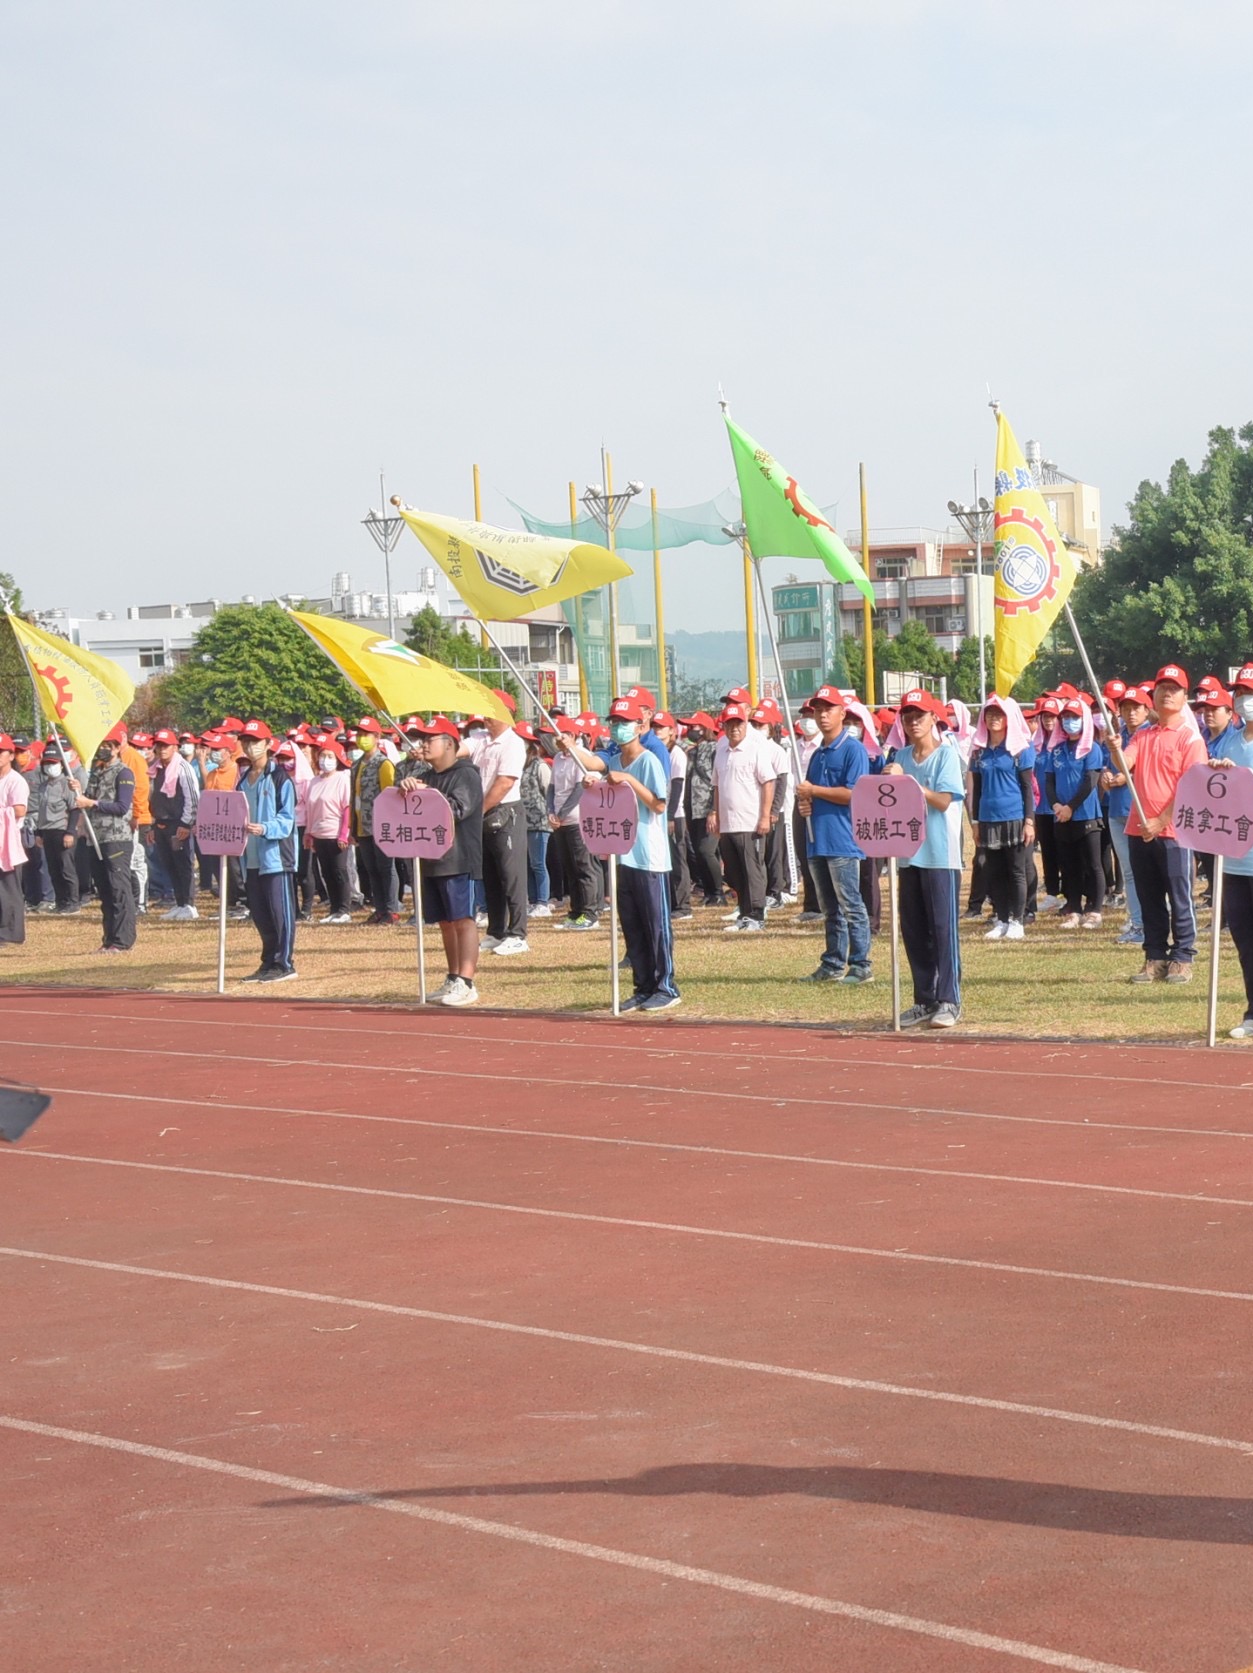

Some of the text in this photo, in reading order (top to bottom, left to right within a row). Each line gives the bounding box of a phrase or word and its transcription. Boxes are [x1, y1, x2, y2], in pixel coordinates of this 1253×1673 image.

[878, 783, 897, 807] 8
[1206, 772, 1228, 799] 6
[215, 796, 229, 816] 14
[402, 794, 423, 816] 12
[599, 787, 615, 809] 10
[379, 822, 448, 846] 星相工會
[856, 817, 922, 841] 被帳工會
[1175, 804, 1253, 841] 推拿工會
